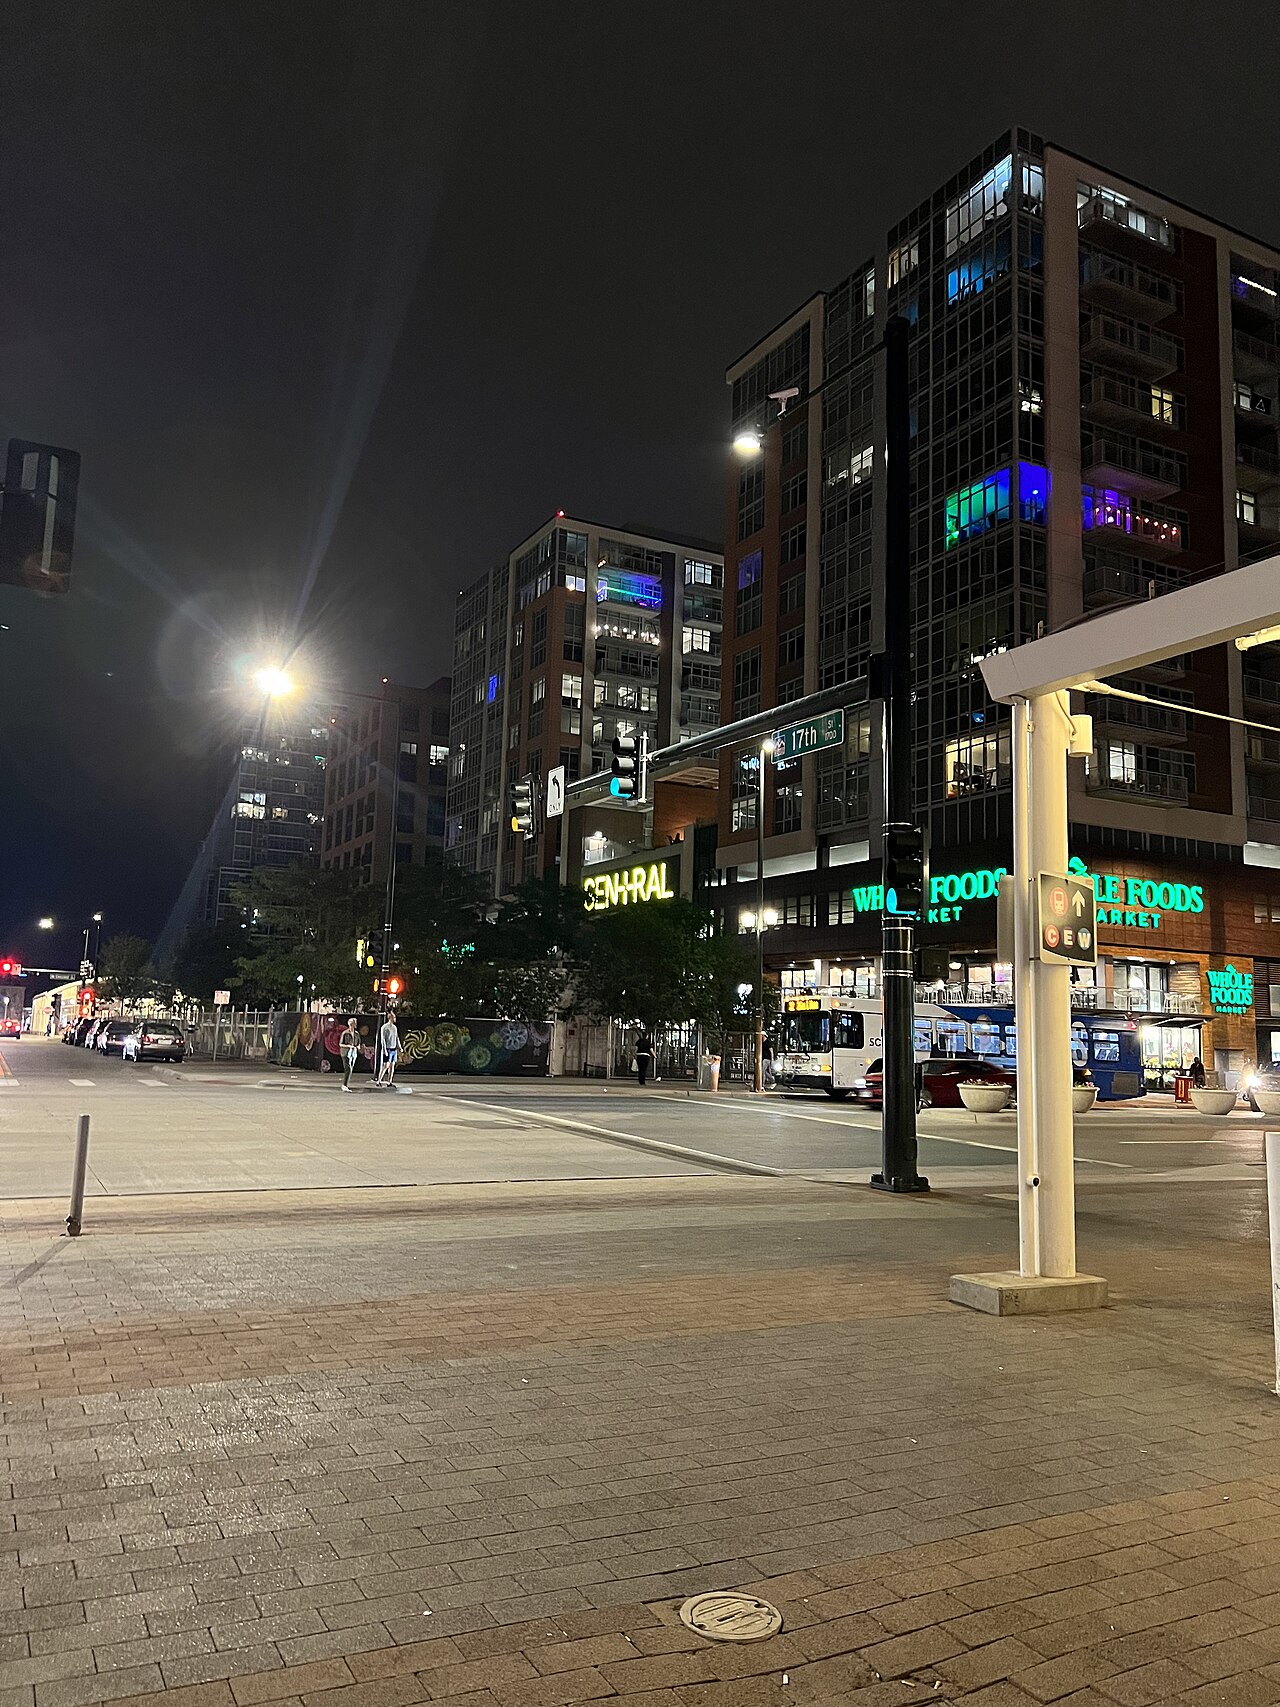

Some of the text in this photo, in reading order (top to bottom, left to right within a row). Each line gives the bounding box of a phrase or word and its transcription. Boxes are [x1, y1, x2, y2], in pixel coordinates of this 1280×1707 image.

[791, 725, 817, 751] 17th
[549, 802, 562, 813] ONLY
[1126, 877, 1204, 913] FOODS
[1096, 907, 1161, 928] ARKET
[1046, 927, 1091, 948] C E W
[1207, 970, 1253, 989] WHOLE
[1210, 986, 1253, 1006] FOODS
[1215, 1005, 1247, 1015] MARKET
